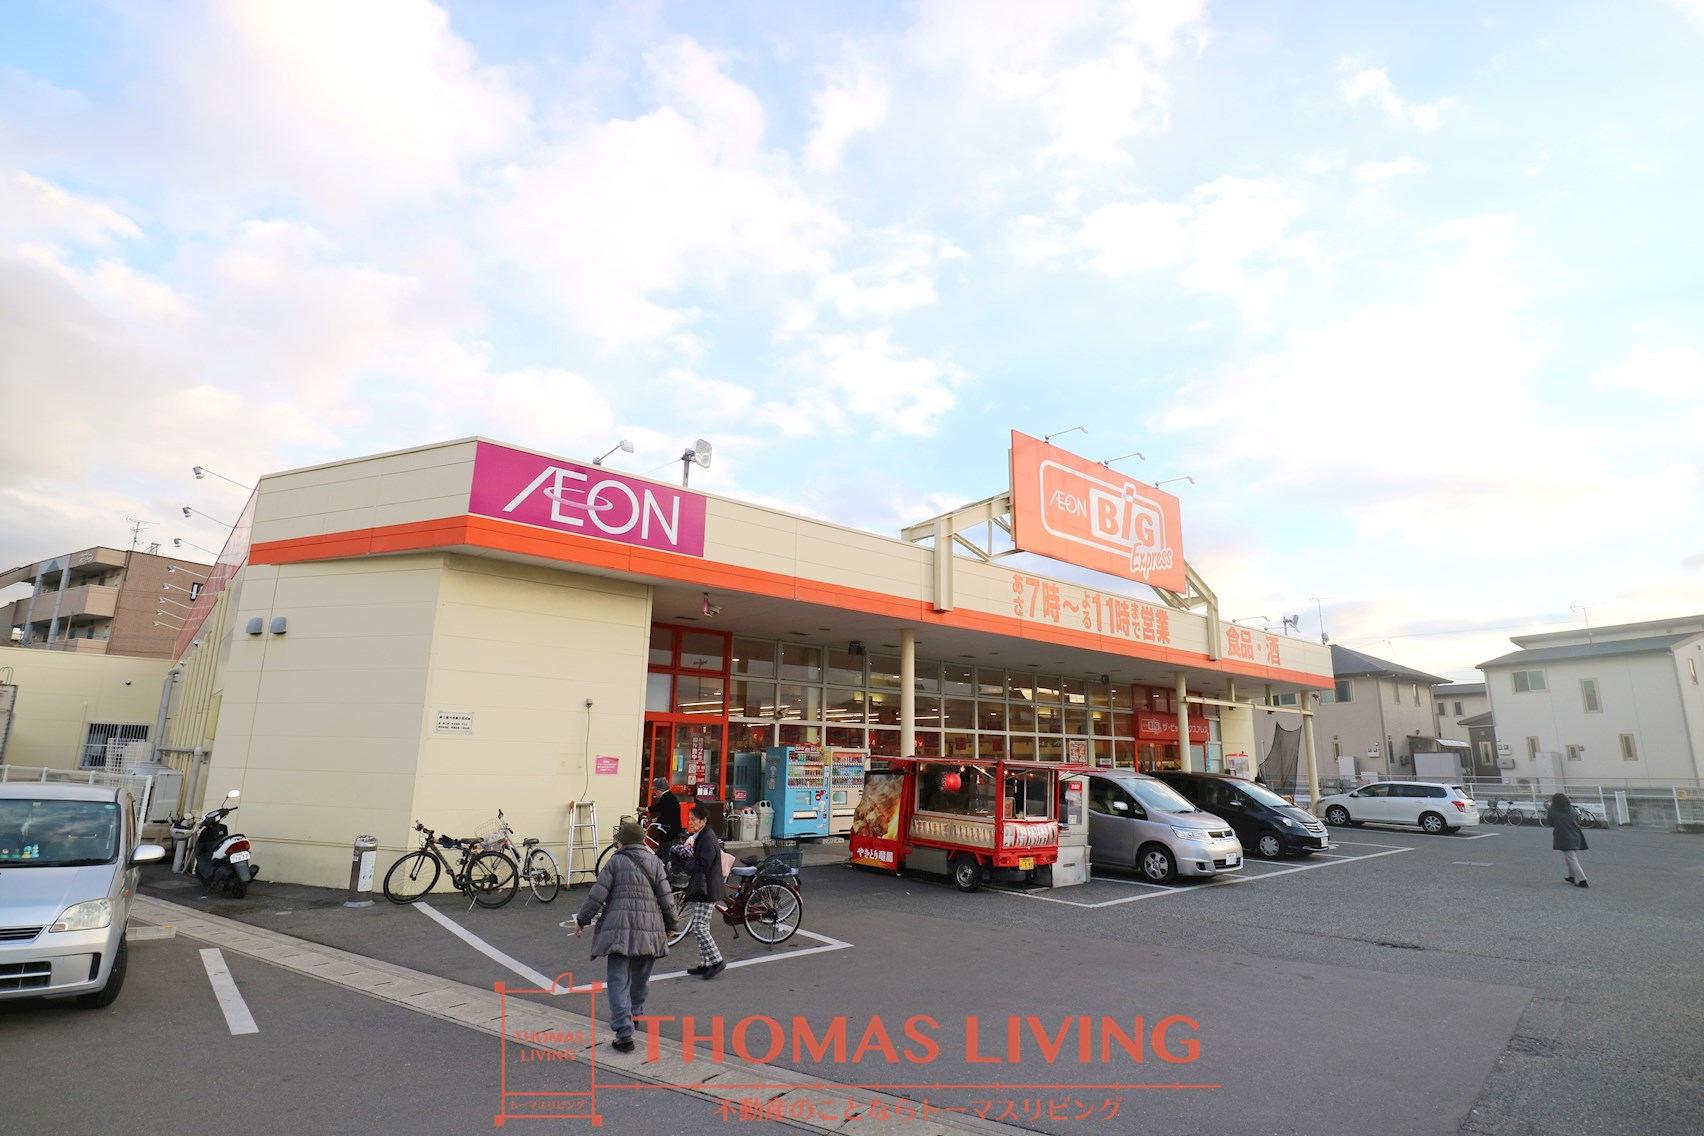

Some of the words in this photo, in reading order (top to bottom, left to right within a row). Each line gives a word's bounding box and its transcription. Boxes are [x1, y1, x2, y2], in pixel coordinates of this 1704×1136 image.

[1130, 541, 1172, 579] Express
[1226, 626, 1280, 666] 食品・酒
